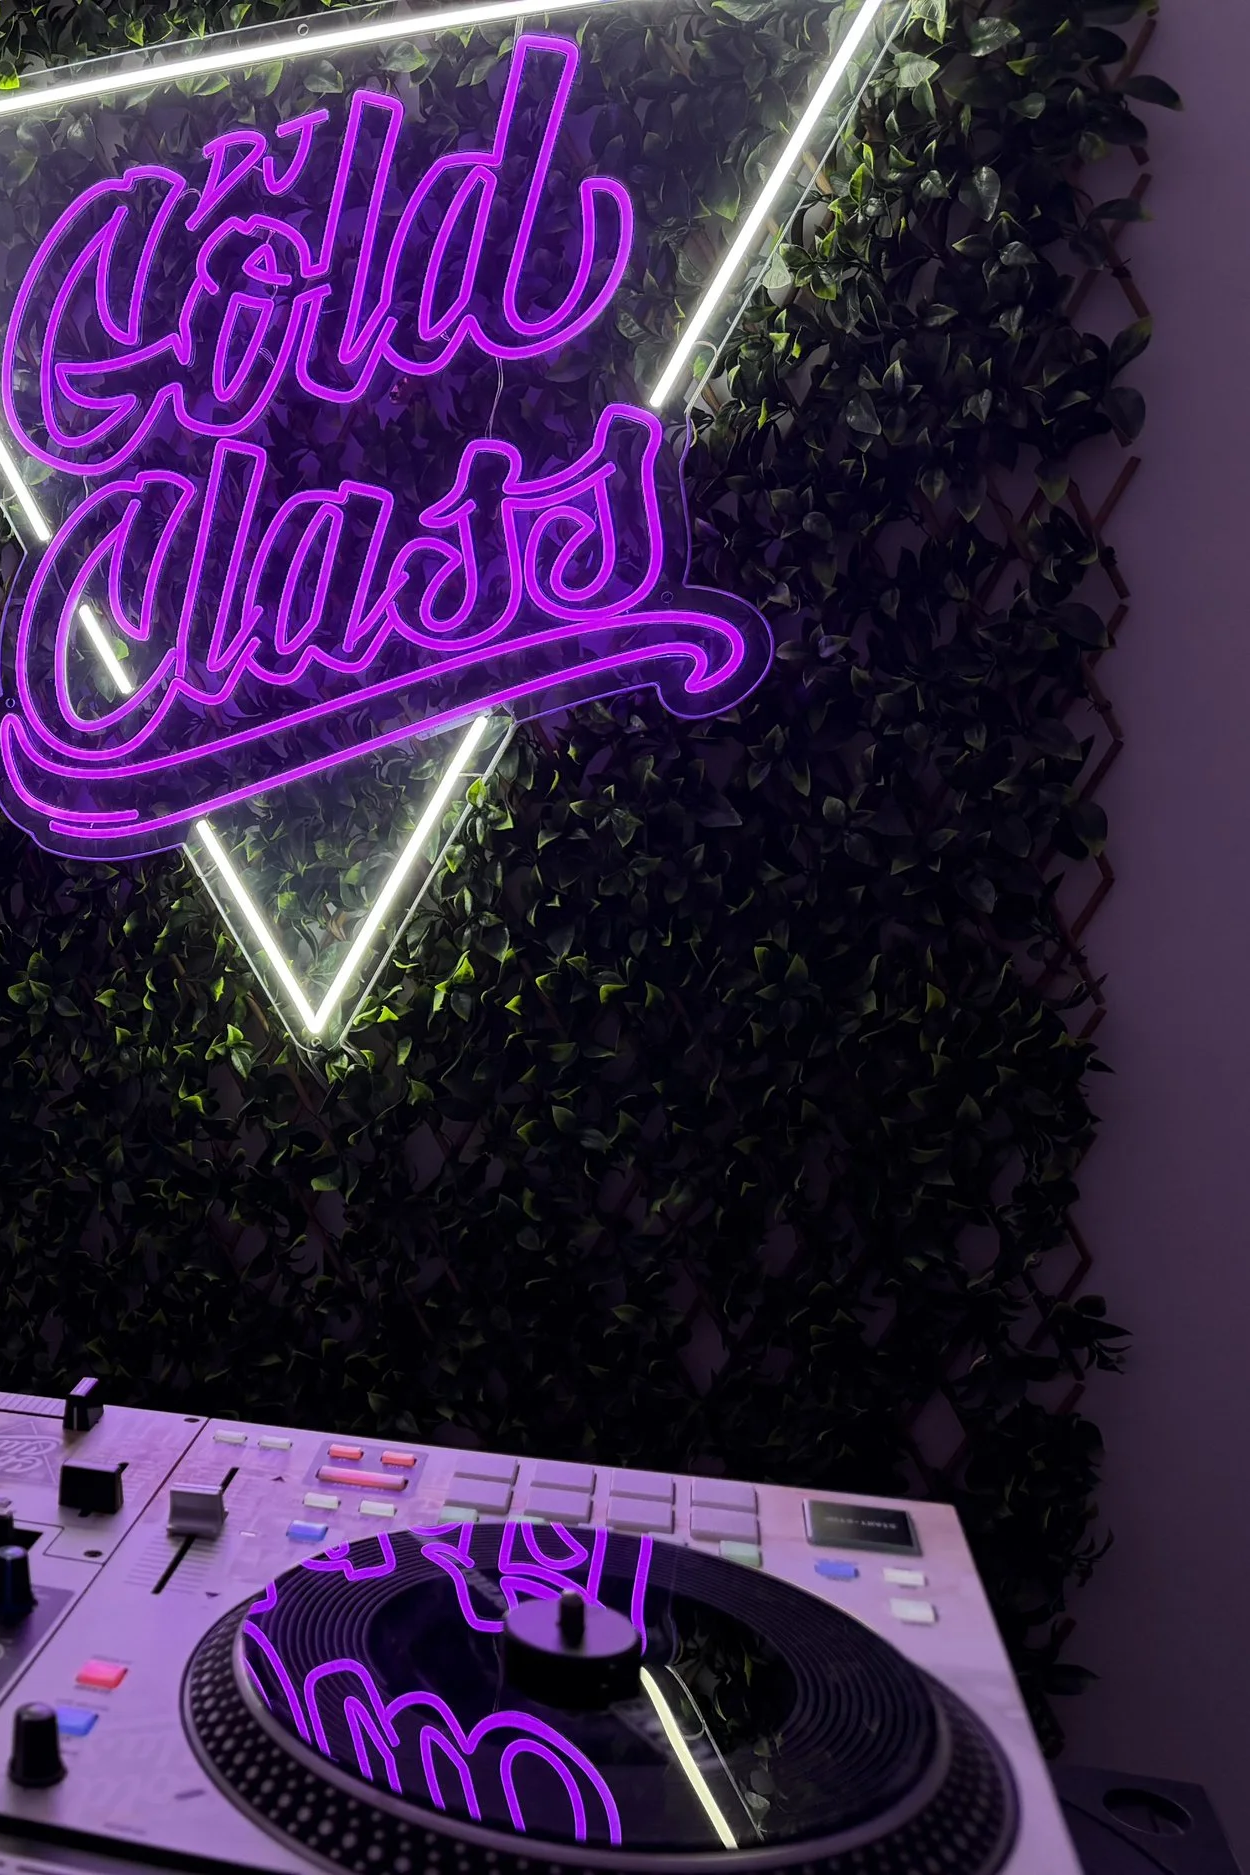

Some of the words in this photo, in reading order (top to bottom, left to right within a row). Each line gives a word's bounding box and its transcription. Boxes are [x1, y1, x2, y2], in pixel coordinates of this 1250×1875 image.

[1, 33, 634, 476] Gold
[185, 108, 330, 231] DJ
[17, 403, 663, 760] Class
